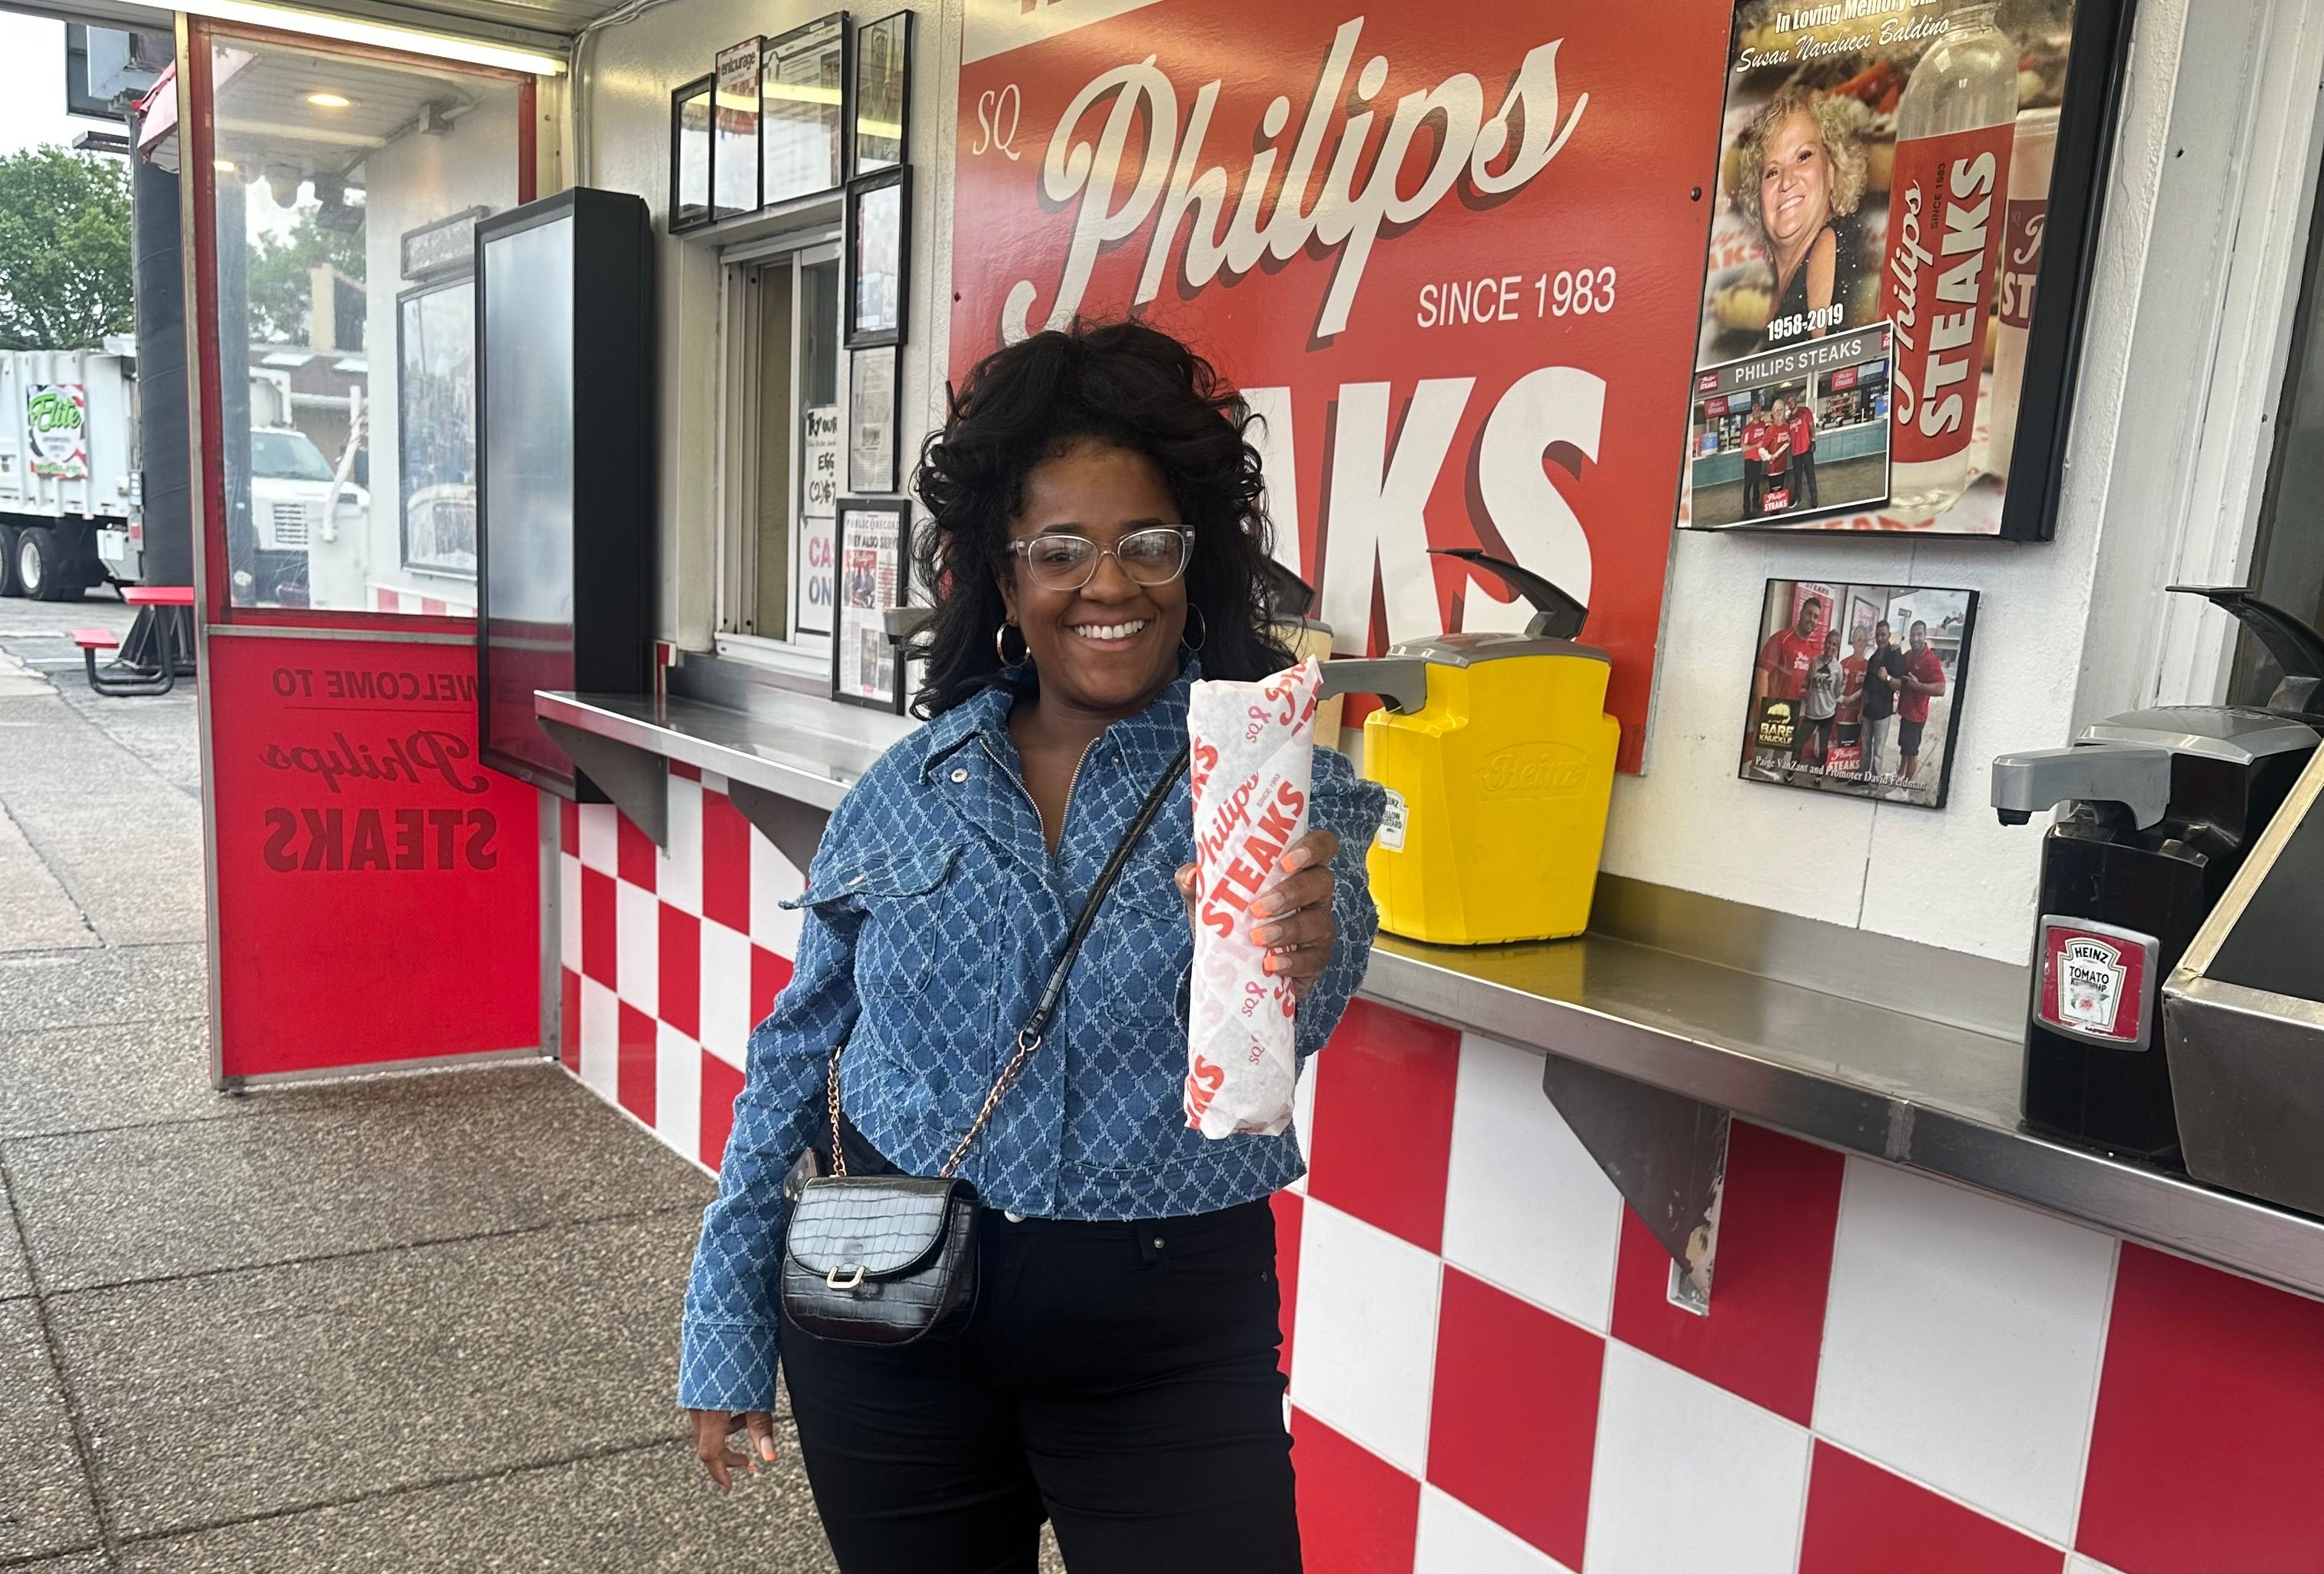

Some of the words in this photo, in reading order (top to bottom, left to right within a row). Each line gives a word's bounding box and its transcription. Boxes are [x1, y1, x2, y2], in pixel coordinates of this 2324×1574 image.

[1775, 12, 1790, 34] In
[1792, 4, 1840, 31] Loving
[1736, 47, 1790, 73] Susan
[1795, 29, 1874, 61] Narducci
[1878, 15, 1950, 45] Baldino
[972, 83, 1021, 161] SQ
[1001, 15, 1589, 339] Philips
[1935, 162, 1946, 188] 1983
[1931, 191, 1941, 230] SINCE
[1417, 276, 1522, 328] SINCE
[1535, 266, 1616, 319] 1983
[1919, 151, 1996, 437] STEAKS
[1768, 303, 1844, 341] 1958-2019
[1735, 356, 1794, 384] PHILIPS
[1798, 339, 1862, 369] STEAKS
[29, 393, 81, 432] Elite
[809, 536, 835, 568] CA
[809, 576, 832, 606] ON
[1245, 722, 1263, 743] SQ
[1755, 755, 1775, 769] Paige
[1809, 764, 1824, 775] and
[1864, 770, 1887, 785] David
[1202, 780, 1305, 938] STEAKS
[2074, 947, 2109, 964] HEINZ
[2070, 965, 2110, 985] TOMATO
[1241, 998, 1259, 1018] SQ
